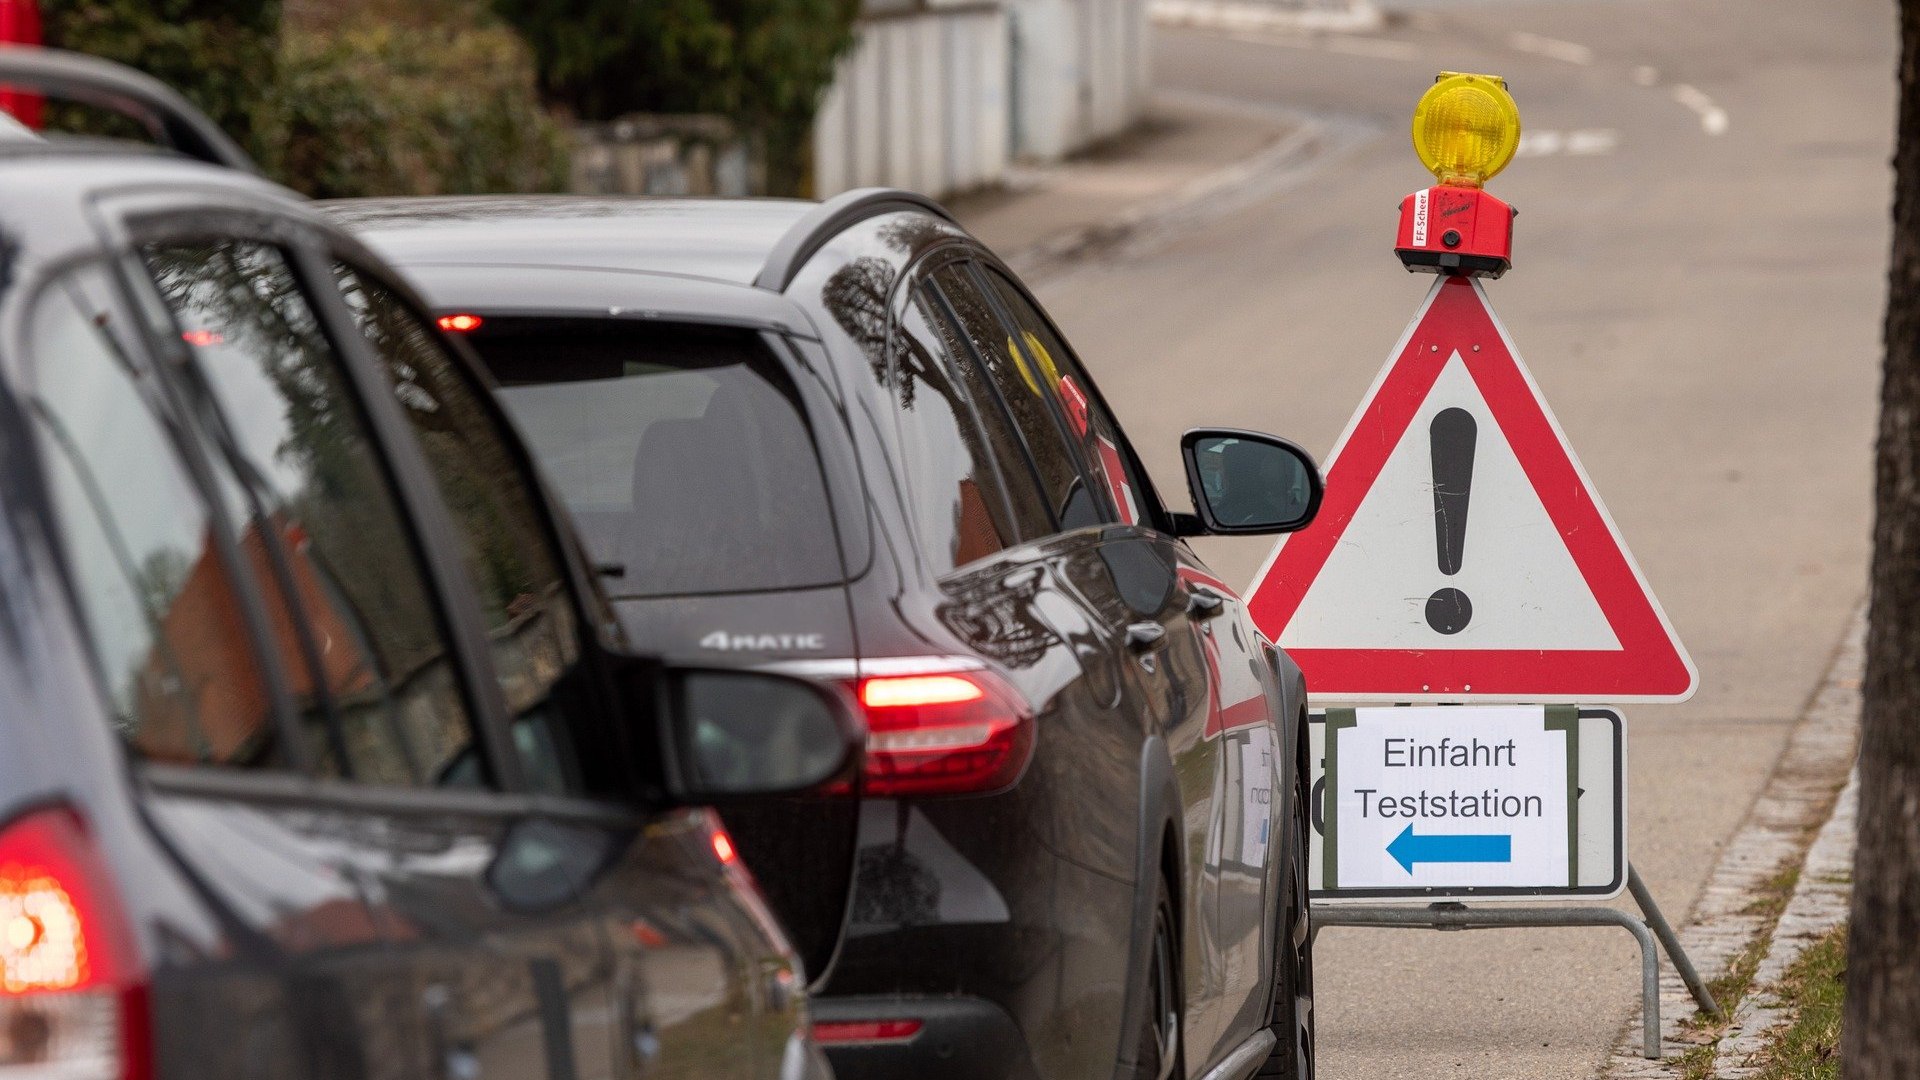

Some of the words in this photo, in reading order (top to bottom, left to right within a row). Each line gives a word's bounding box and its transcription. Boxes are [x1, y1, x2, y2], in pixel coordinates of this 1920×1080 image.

[1416, 194, 1427, 241] FF-Scheer
[700, 630, 825, 650] 4MATIC
[1384, 738, 1516, 767] Einfahrt
[1354, 788, 1542, 818] Teststation
